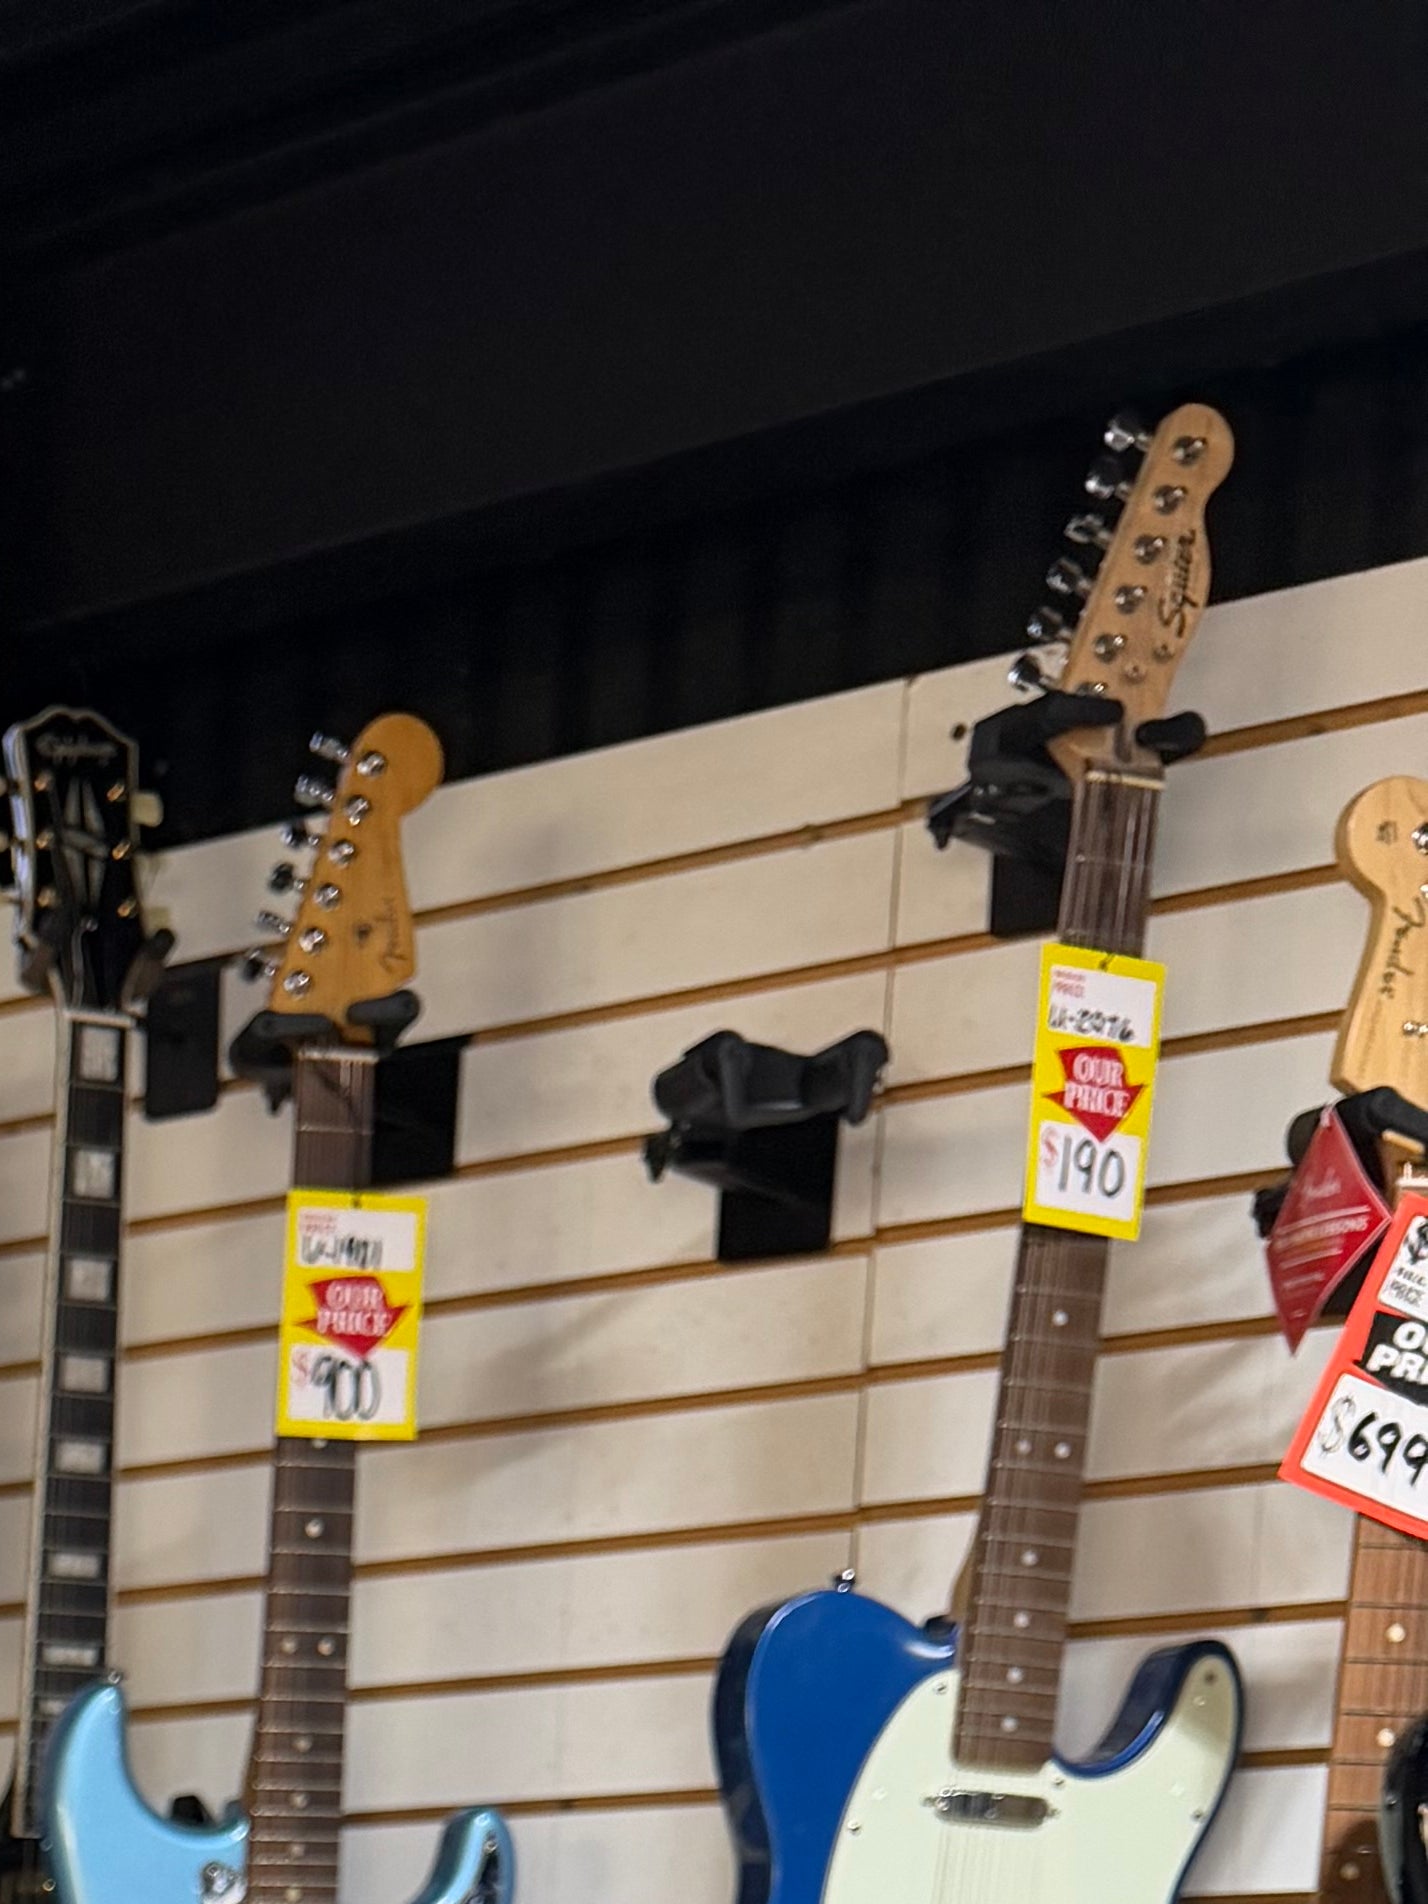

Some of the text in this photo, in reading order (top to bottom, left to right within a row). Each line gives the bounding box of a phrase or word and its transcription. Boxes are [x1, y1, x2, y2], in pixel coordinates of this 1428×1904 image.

[1157, 528, 1199, 639] Squier
[1376, 897, 1428, 1000] Fender
[1072, 1051, 1125, 1090] OUR
[1063, 1081, 1132, 1118] PRICE
[325, 1280, 385, 1310] OUR
[316, 1310, 393, 1337] PRICE
